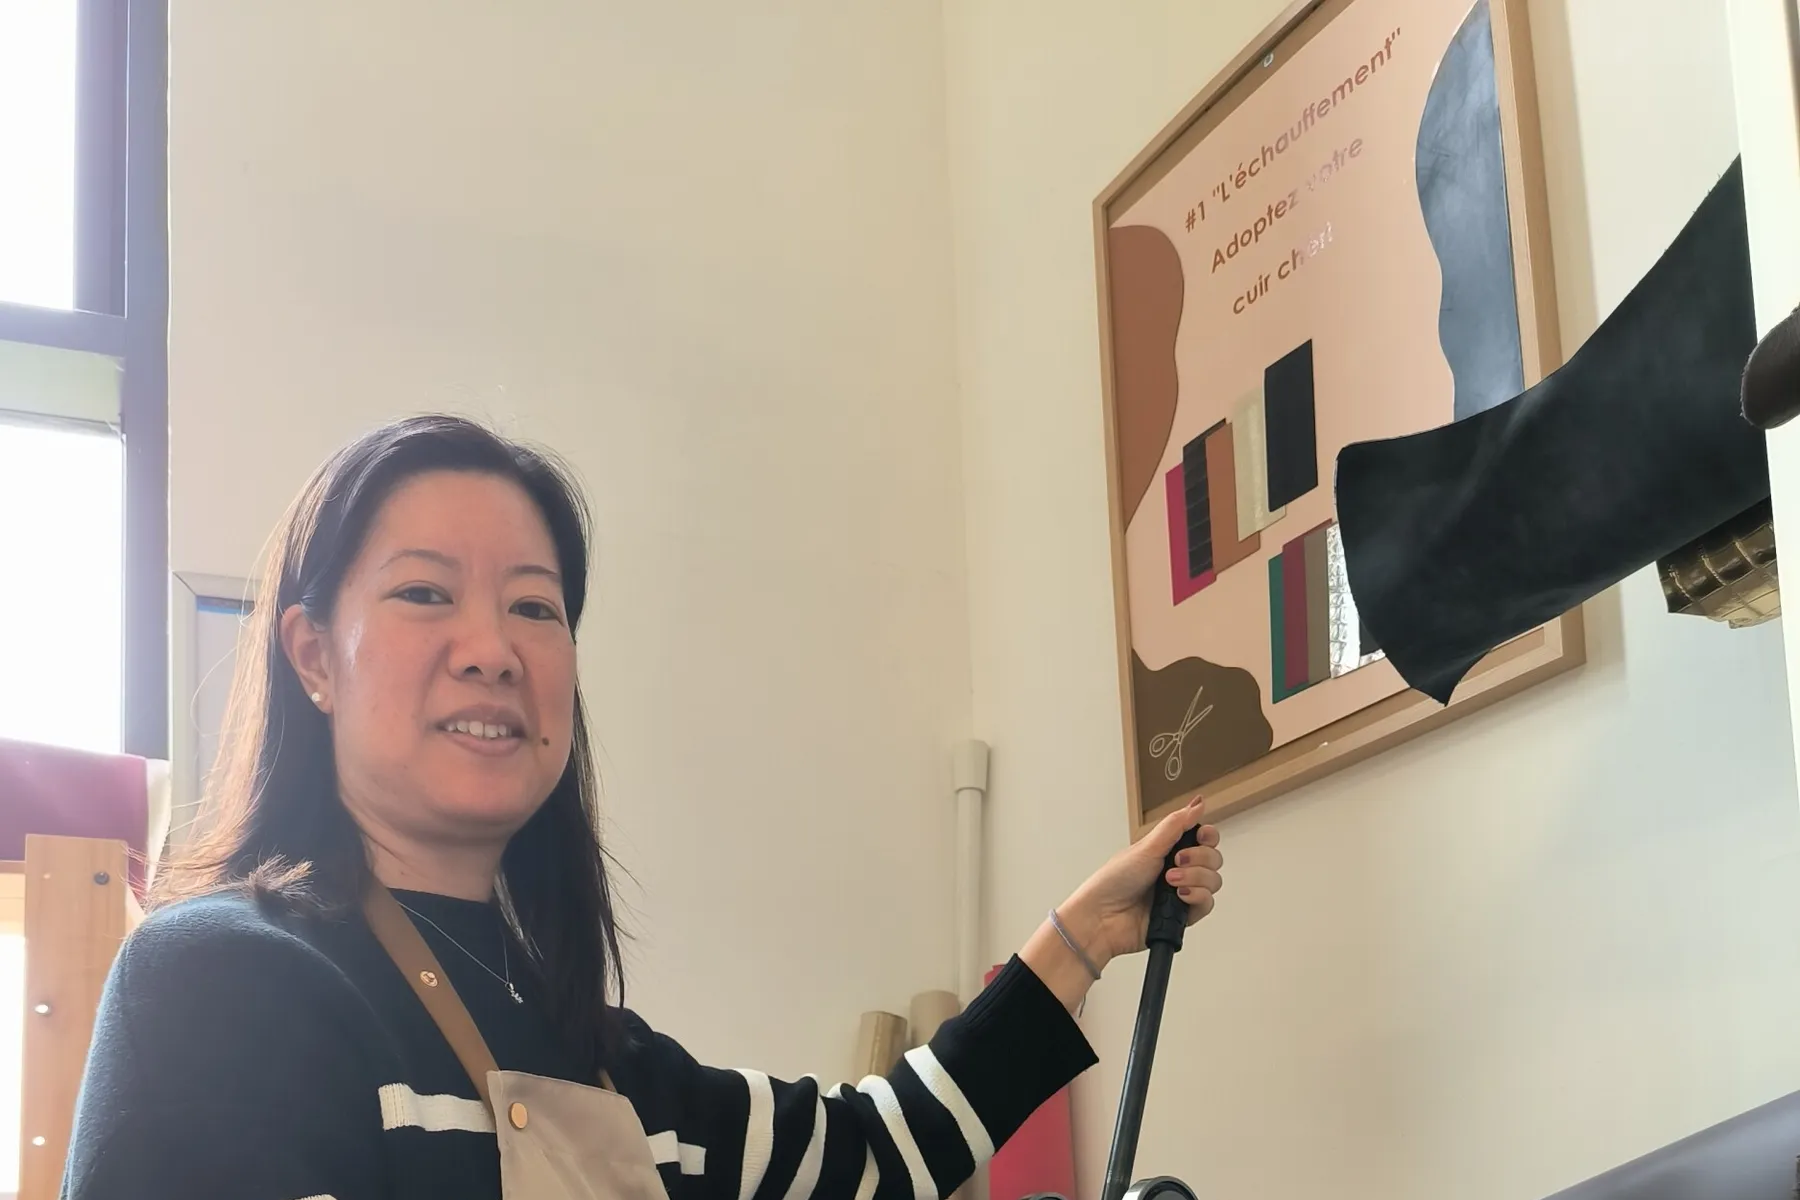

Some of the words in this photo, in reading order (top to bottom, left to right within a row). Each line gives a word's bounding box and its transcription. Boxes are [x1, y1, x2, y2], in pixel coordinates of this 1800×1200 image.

[1185, 201, 1206, 233] #1
[1211, 188, 1300, 274] Adoptez
[1306, 138, 1363, 192] votre
[1232, 273, 1271, 314] cuir
